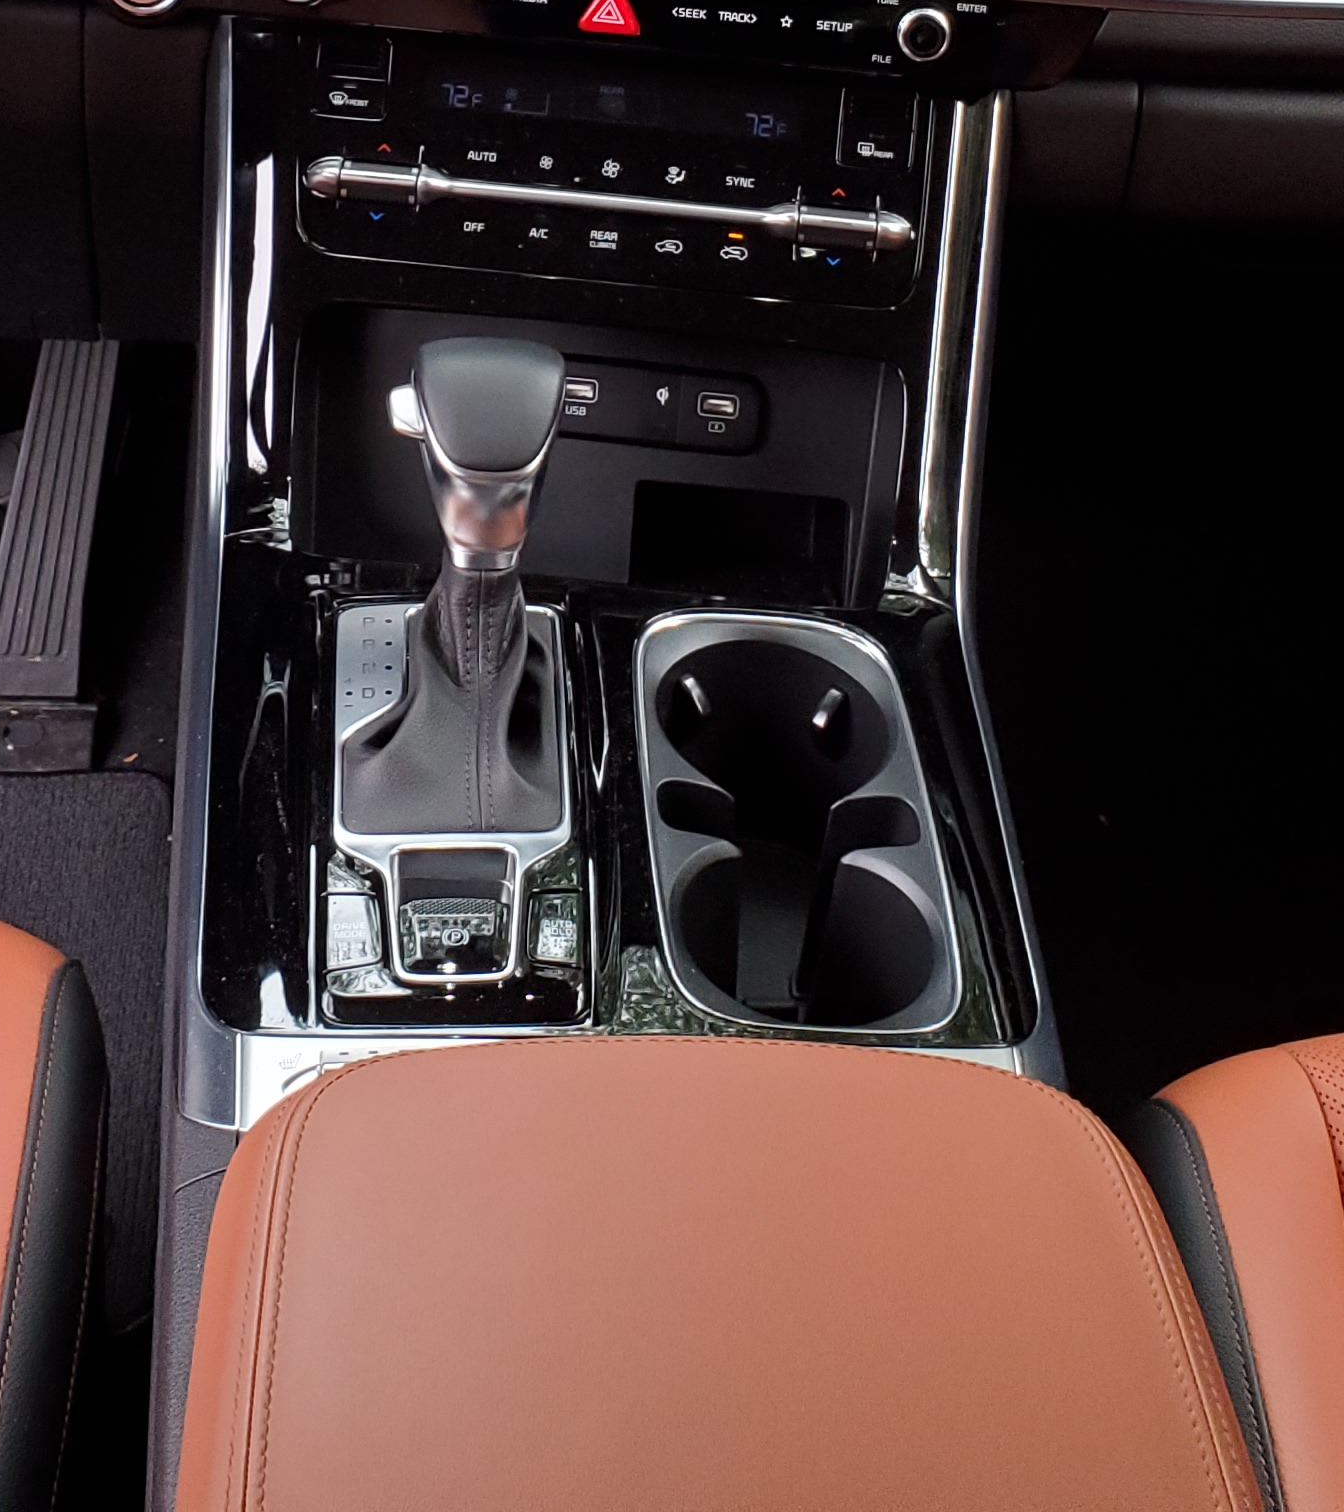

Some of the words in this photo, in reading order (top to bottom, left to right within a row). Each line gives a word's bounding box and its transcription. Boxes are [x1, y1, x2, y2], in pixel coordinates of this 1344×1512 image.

[956, 3, 987, 14] ENTER
[816, 20, 853, 33] SETUP
[871, 54, 892, 64] FILE
[467, 150, 497, 162] AUTO
[725, 176, 755, 188] SYNC
[463, 222, 485, 232] OFF
[529, 227, 549, 239] A/C
[590, 230, 618, 241] REAR
[565, 405, 587, 417] USB
[362, 687, 375, 699] D
[333, 922, 365, 931] DRIVE
[544, 920, 573, 929] AUTO
